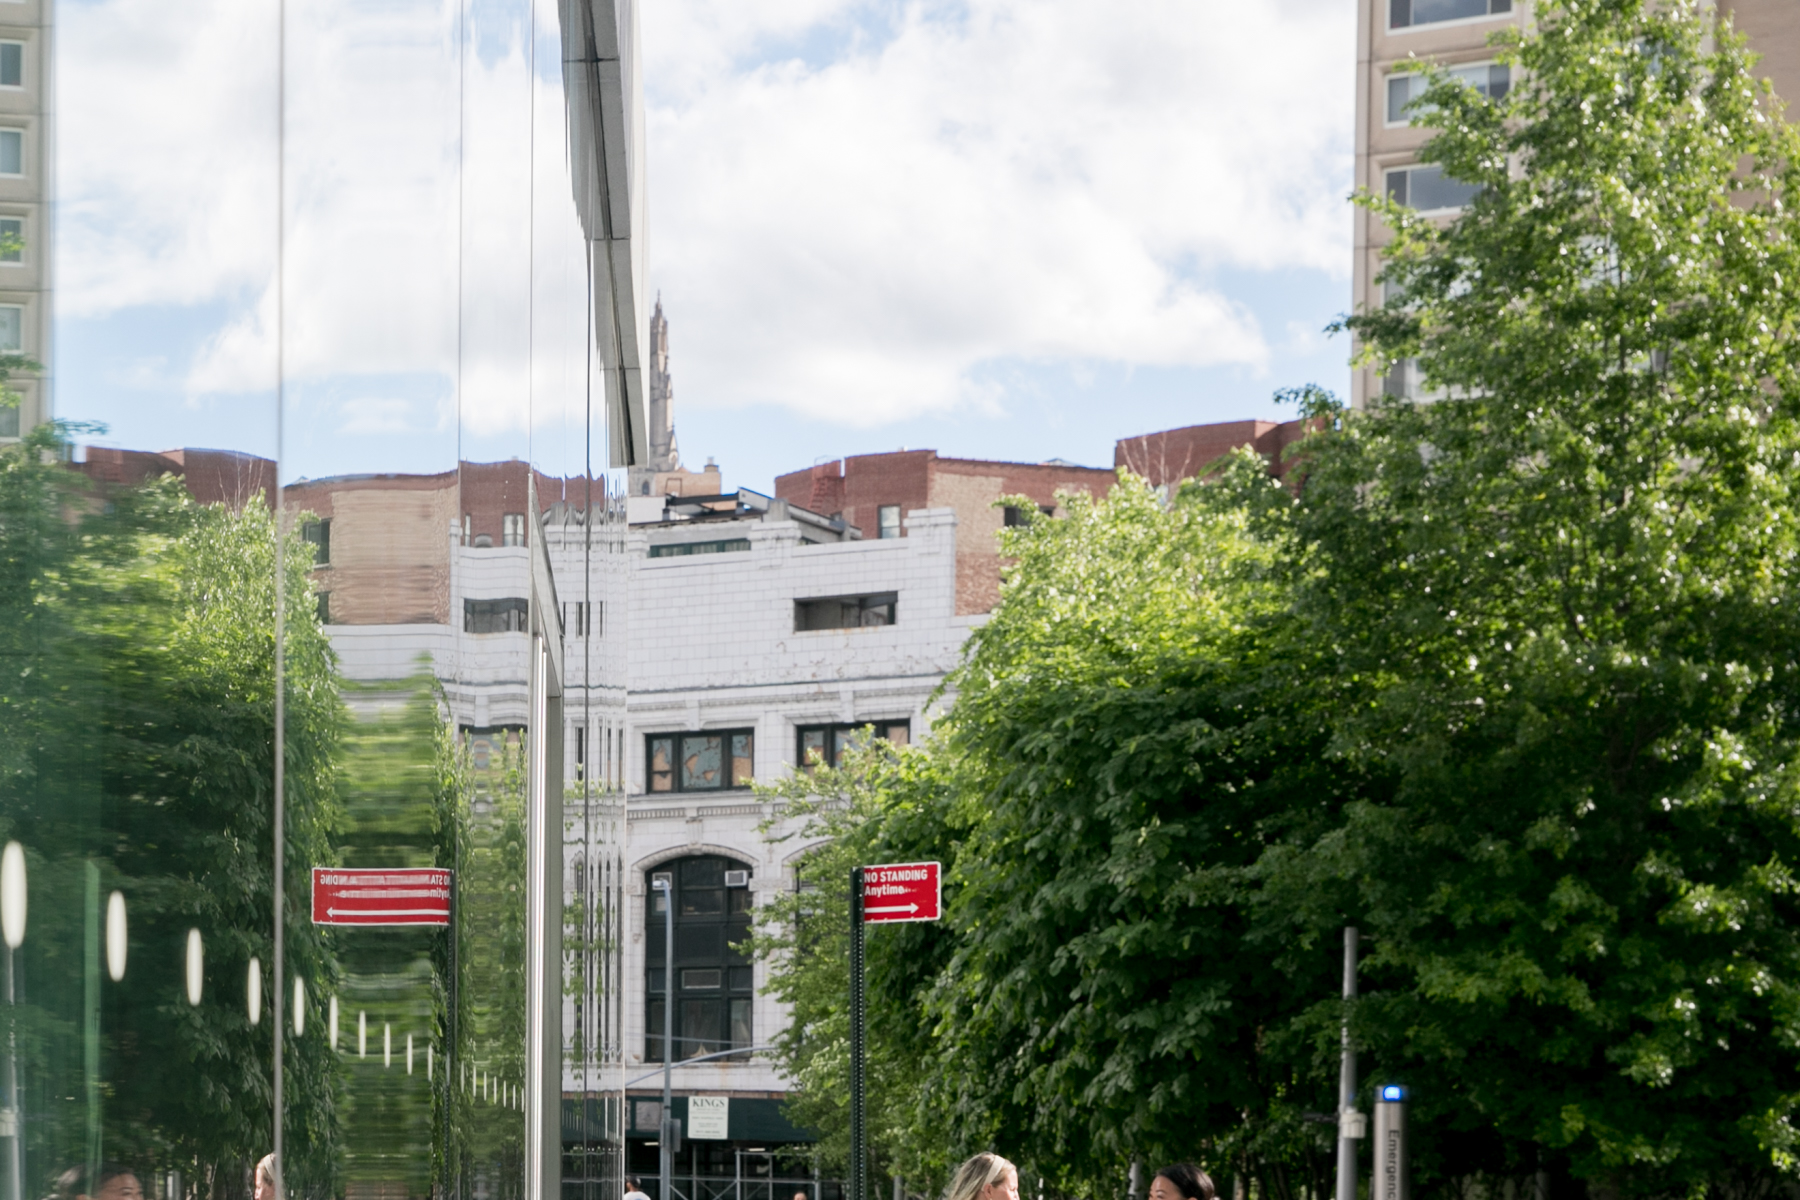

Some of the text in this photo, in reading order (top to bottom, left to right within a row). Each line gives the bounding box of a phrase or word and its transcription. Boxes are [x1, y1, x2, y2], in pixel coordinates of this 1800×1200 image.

[864, 869, 928, 883] NO STANDING
[865, 884, 904, 898] Anytime
[693, 1098, 725, 1107] KINGS
